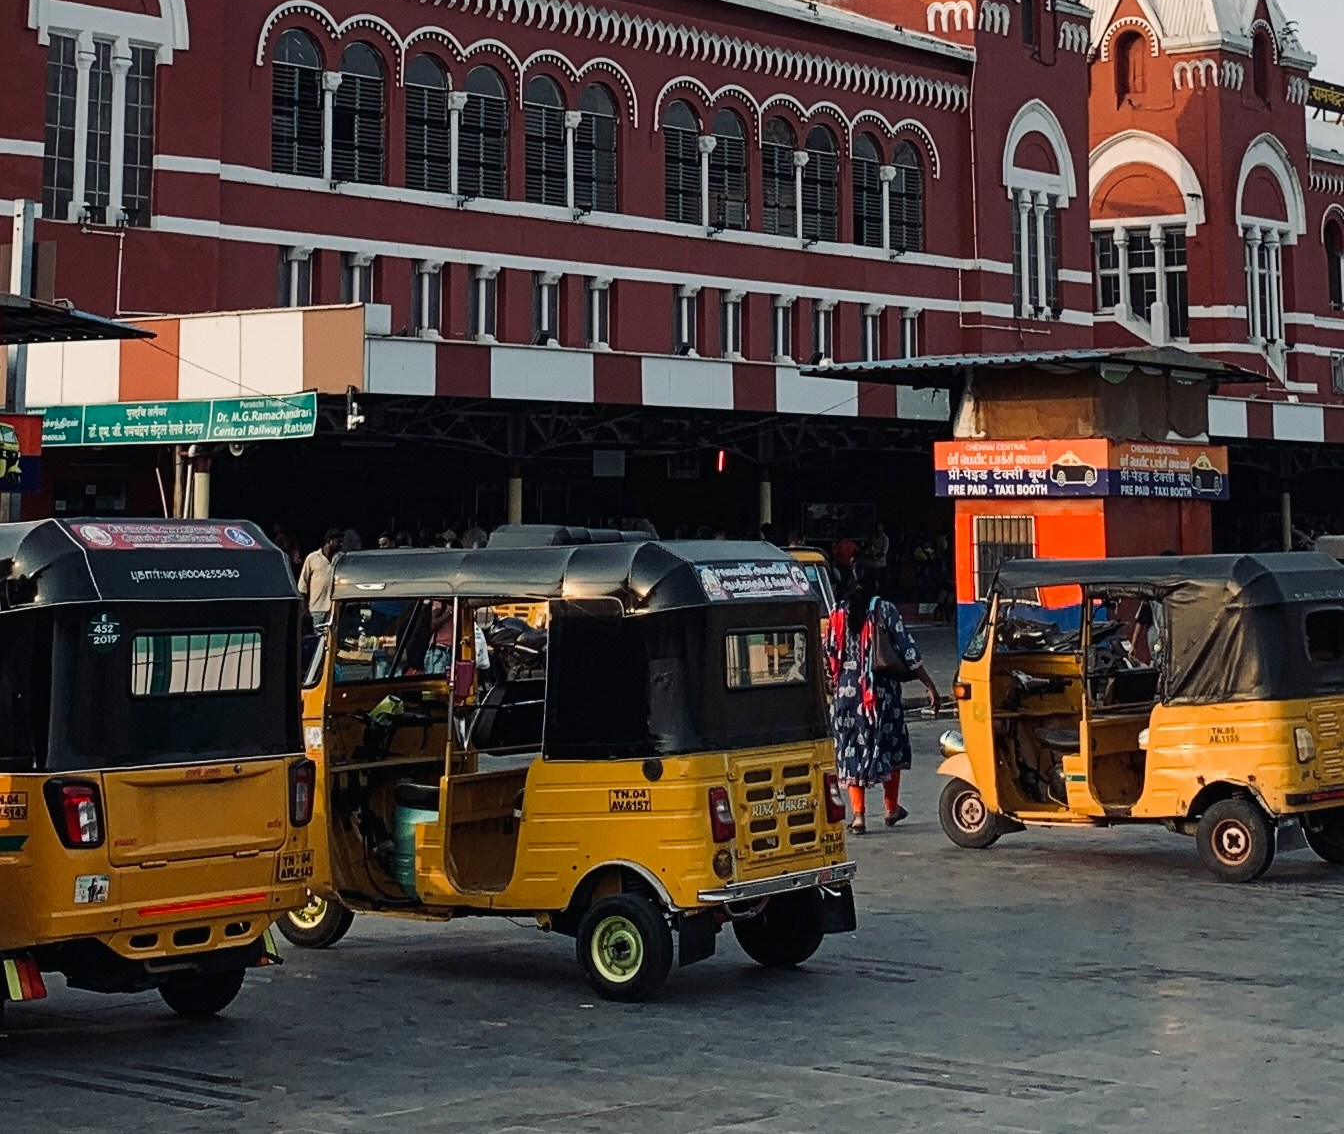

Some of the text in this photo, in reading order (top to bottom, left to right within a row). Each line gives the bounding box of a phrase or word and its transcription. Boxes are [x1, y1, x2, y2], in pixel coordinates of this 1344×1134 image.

[216, 412, 229, 422] Dr.
[213, 422, 312, 436] Central Railway Station
[993, 466, 1024, 480] टैक्सी
[948, 484, 1048, 495] PRE PAID TAXI BOOTH
[1120, 485, 1192, 497] PRE PAID TAXI BOOTH
[93, 624, 114, 633] 452
[93, 635, 118, 645] 2019
[613, 789, 646, 798] TN.04
[752, 798, 808, 817] KING MAKER
